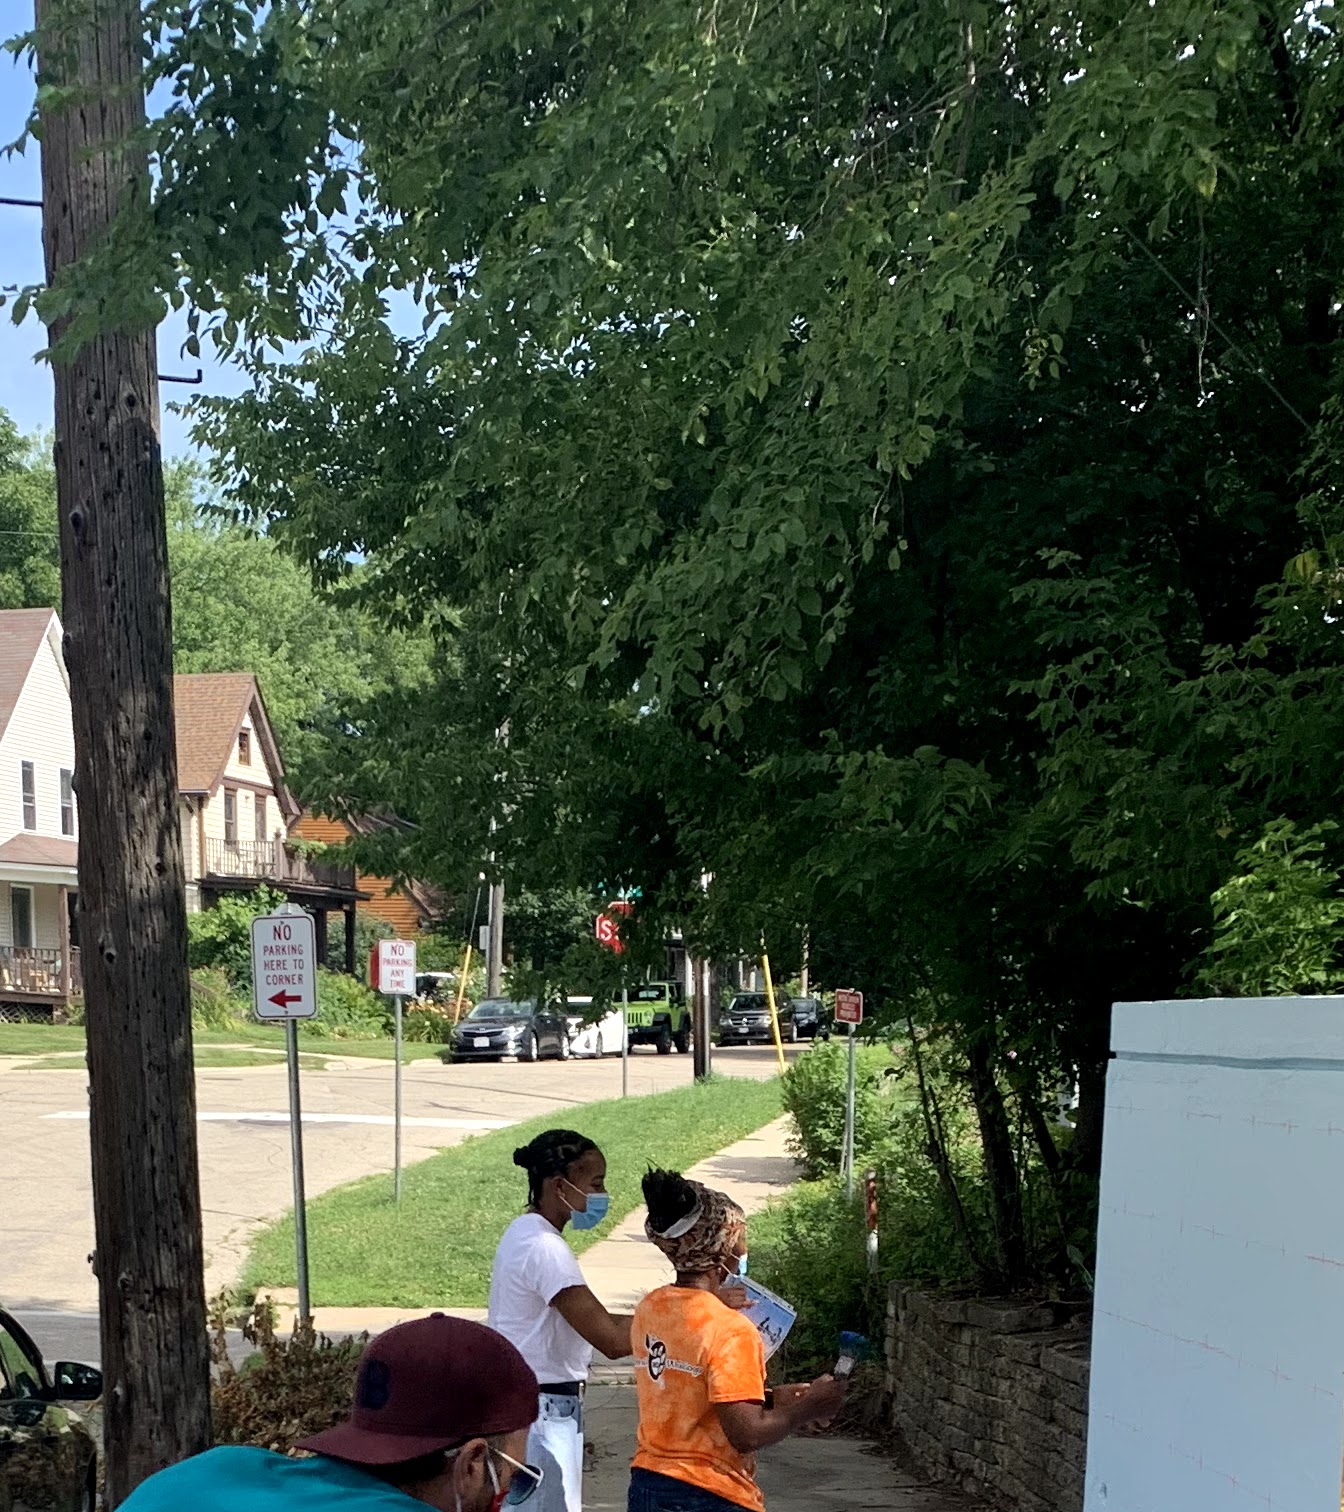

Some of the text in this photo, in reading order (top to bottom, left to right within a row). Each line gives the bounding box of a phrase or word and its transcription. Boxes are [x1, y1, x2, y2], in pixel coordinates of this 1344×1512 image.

[273, 924, 292, 941] NO
[263, 944, 304, 956] PARKING
[390, 945, 405, 956] NO
[263, 958, 305, 971] HERE TO
[382, 957, 413, 967] PARKING
[390, 969, 404, 978] ANY
[265, 974, 304, 986] CORNER
[390, 979, 406, 989] TIME
